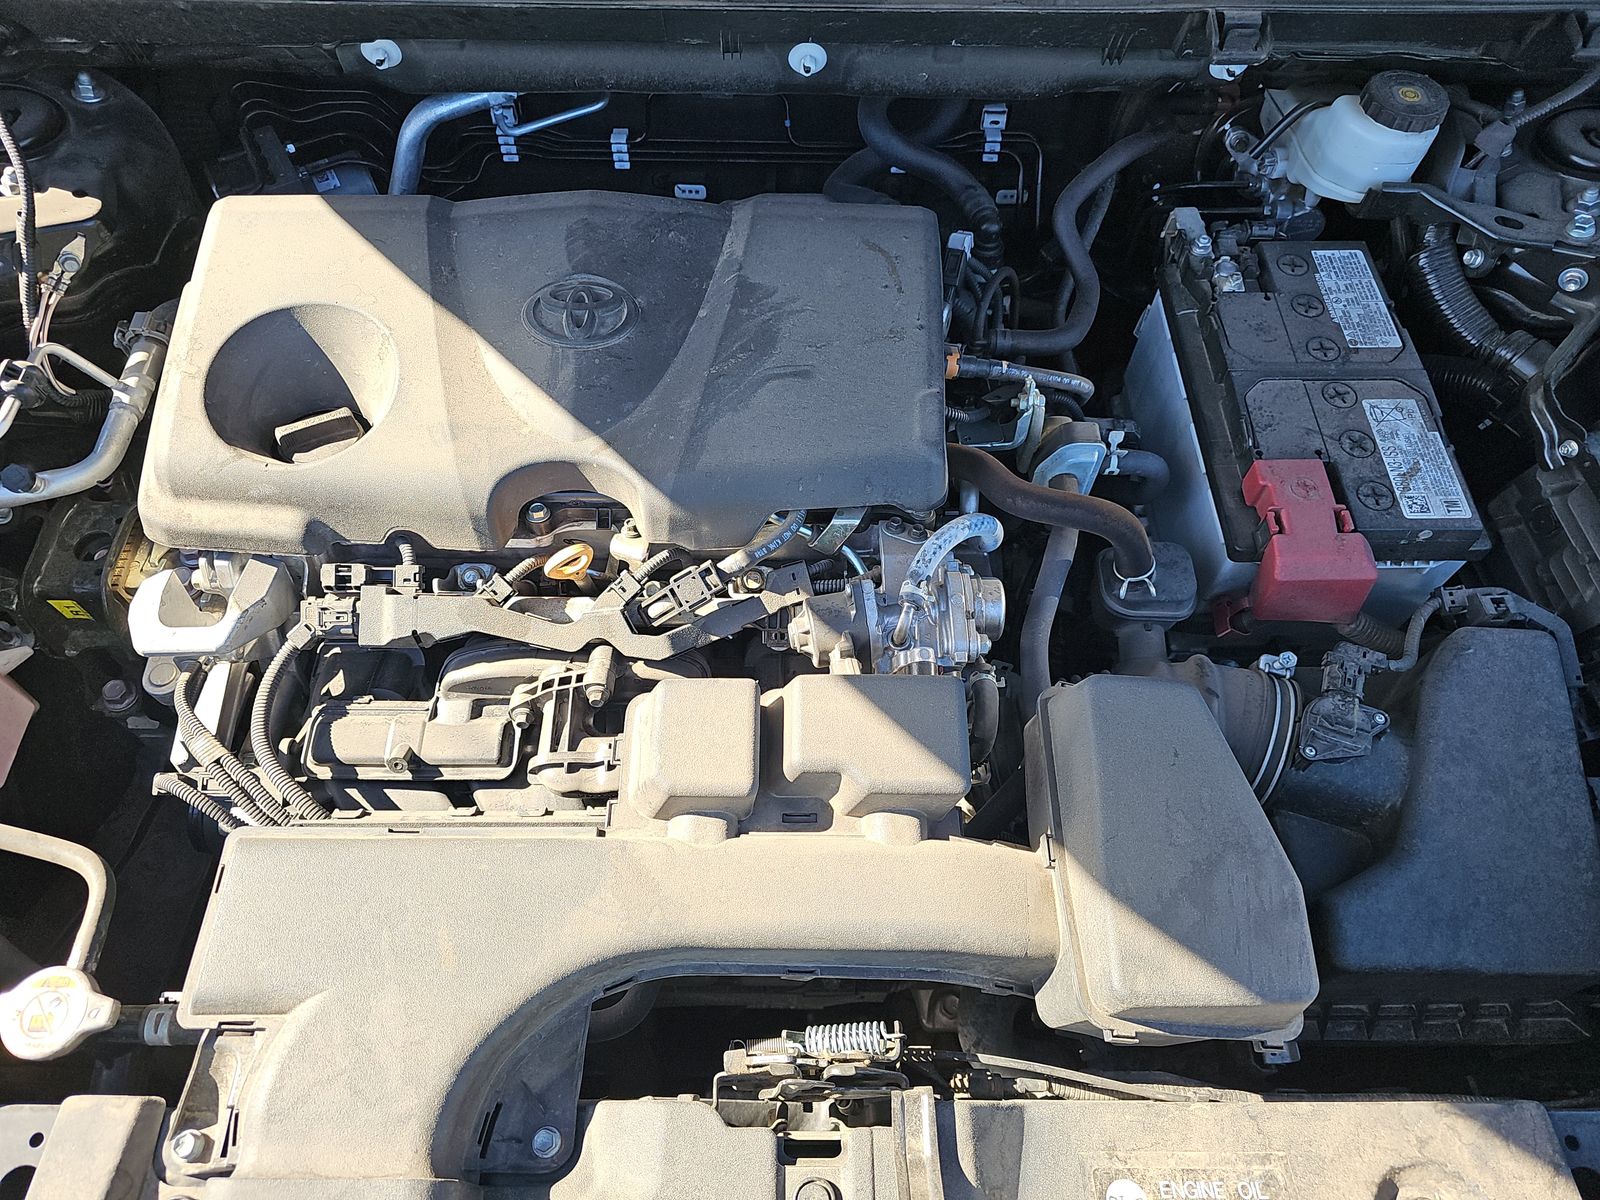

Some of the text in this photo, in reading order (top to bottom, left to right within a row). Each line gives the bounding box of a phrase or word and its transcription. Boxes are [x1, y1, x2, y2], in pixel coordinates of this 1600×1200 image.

[1443, 500, 1462, 513] TM
[781, 530, 793, 542] NOT
[767, 538, 783, 552] KINK
[1158, 1180, 1270, 1200] ENGINE OIL
